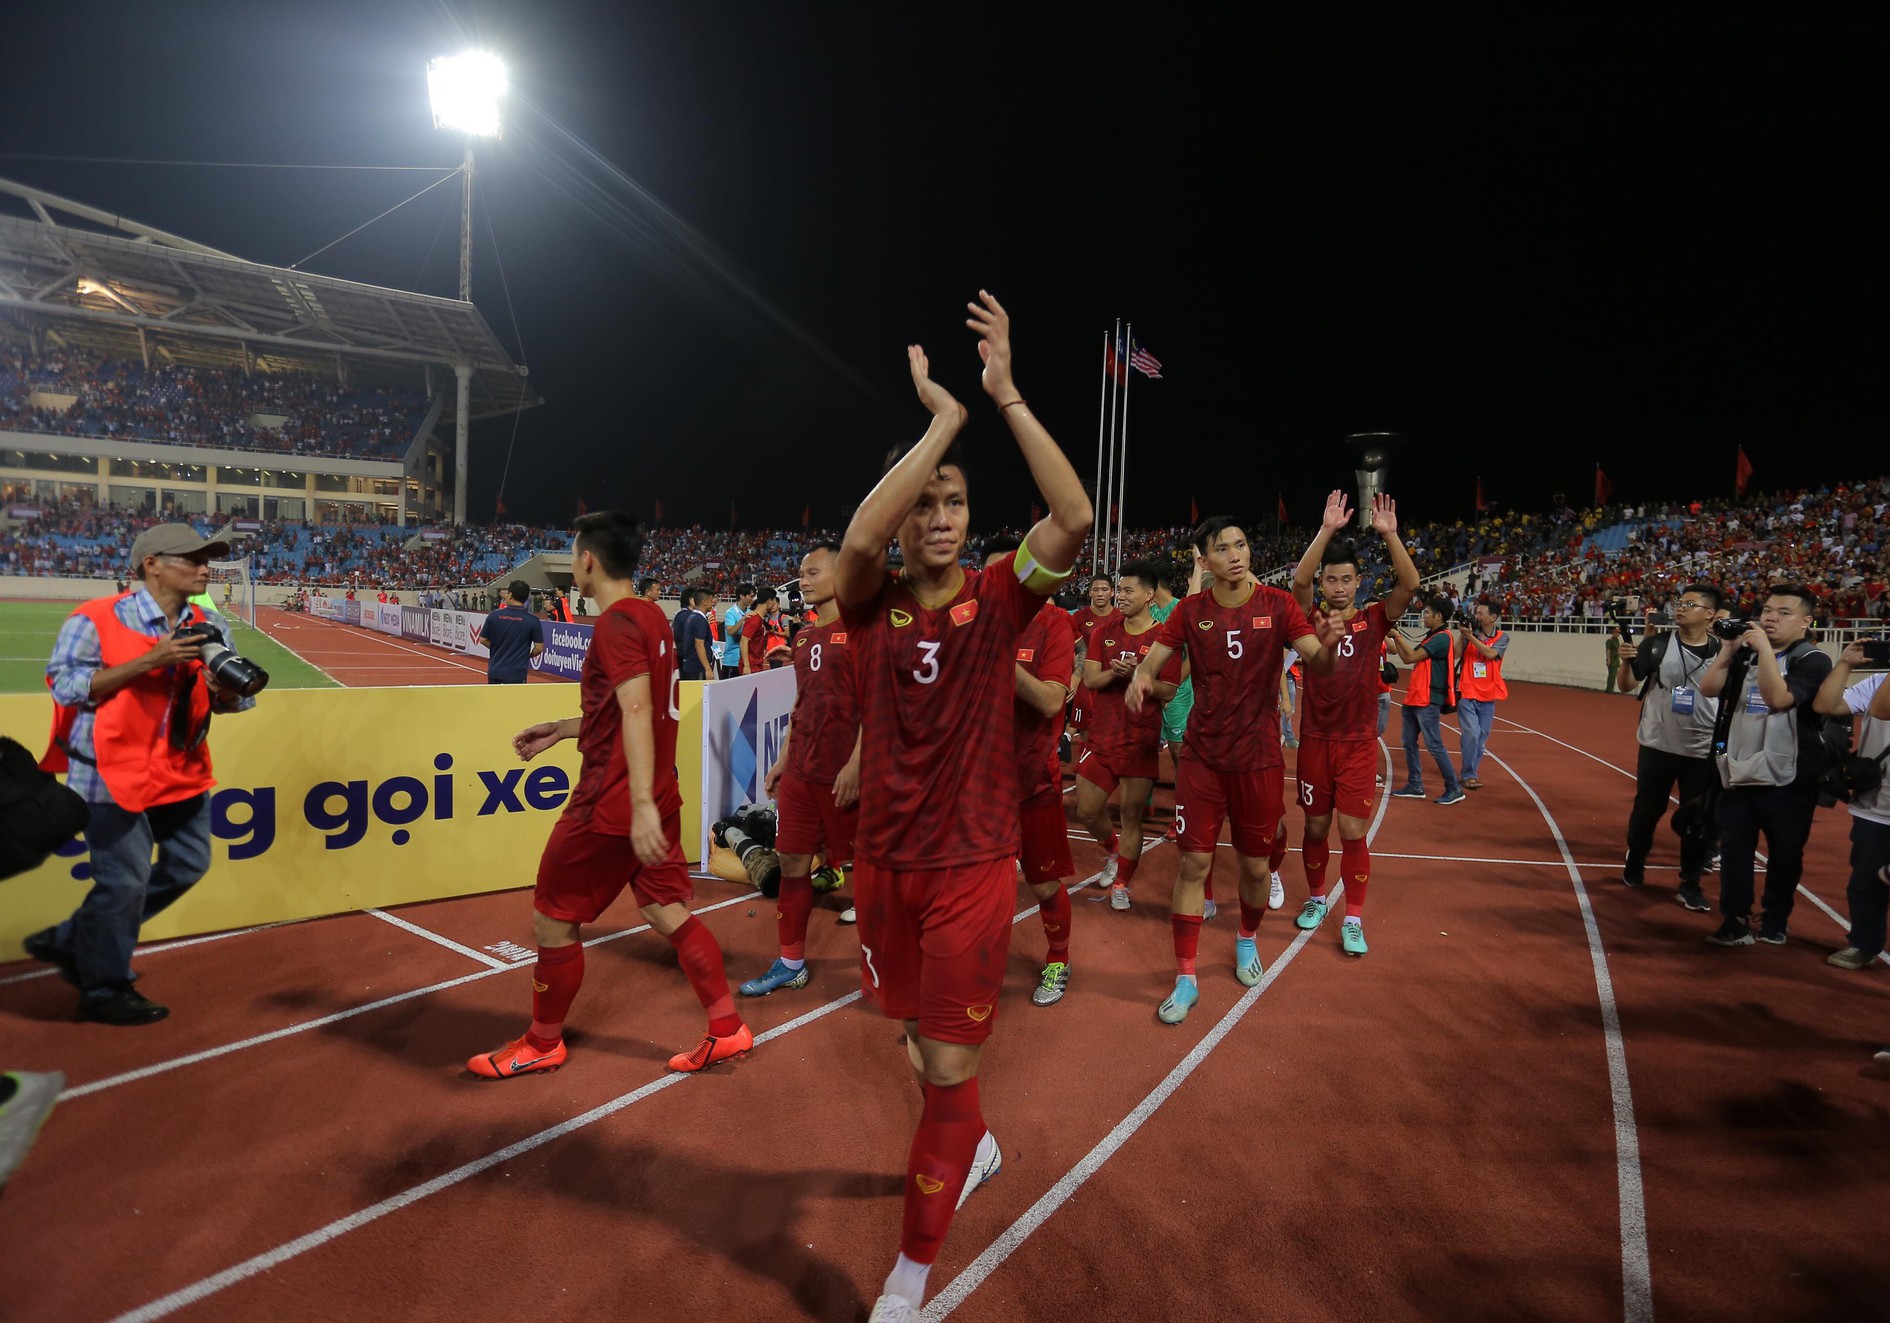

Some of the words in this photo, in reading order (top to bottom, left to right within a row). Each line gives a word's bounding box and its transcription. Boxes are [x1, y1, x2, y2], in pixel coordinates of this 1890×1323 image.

[402, 610, 430, 638] VINAMILK
[810, 643, 821, 672] 8
[1226, 630, 1243, 659] 5
[1337, 635, 1354, 657] 13
[913, 641, 941, 685] 3
[303, 752, 454, 850] gọi
[476, 765, 570, 816] xe
[1301, 780, 1313, 806] 13
[1175, 804, 1186, 834] 5
